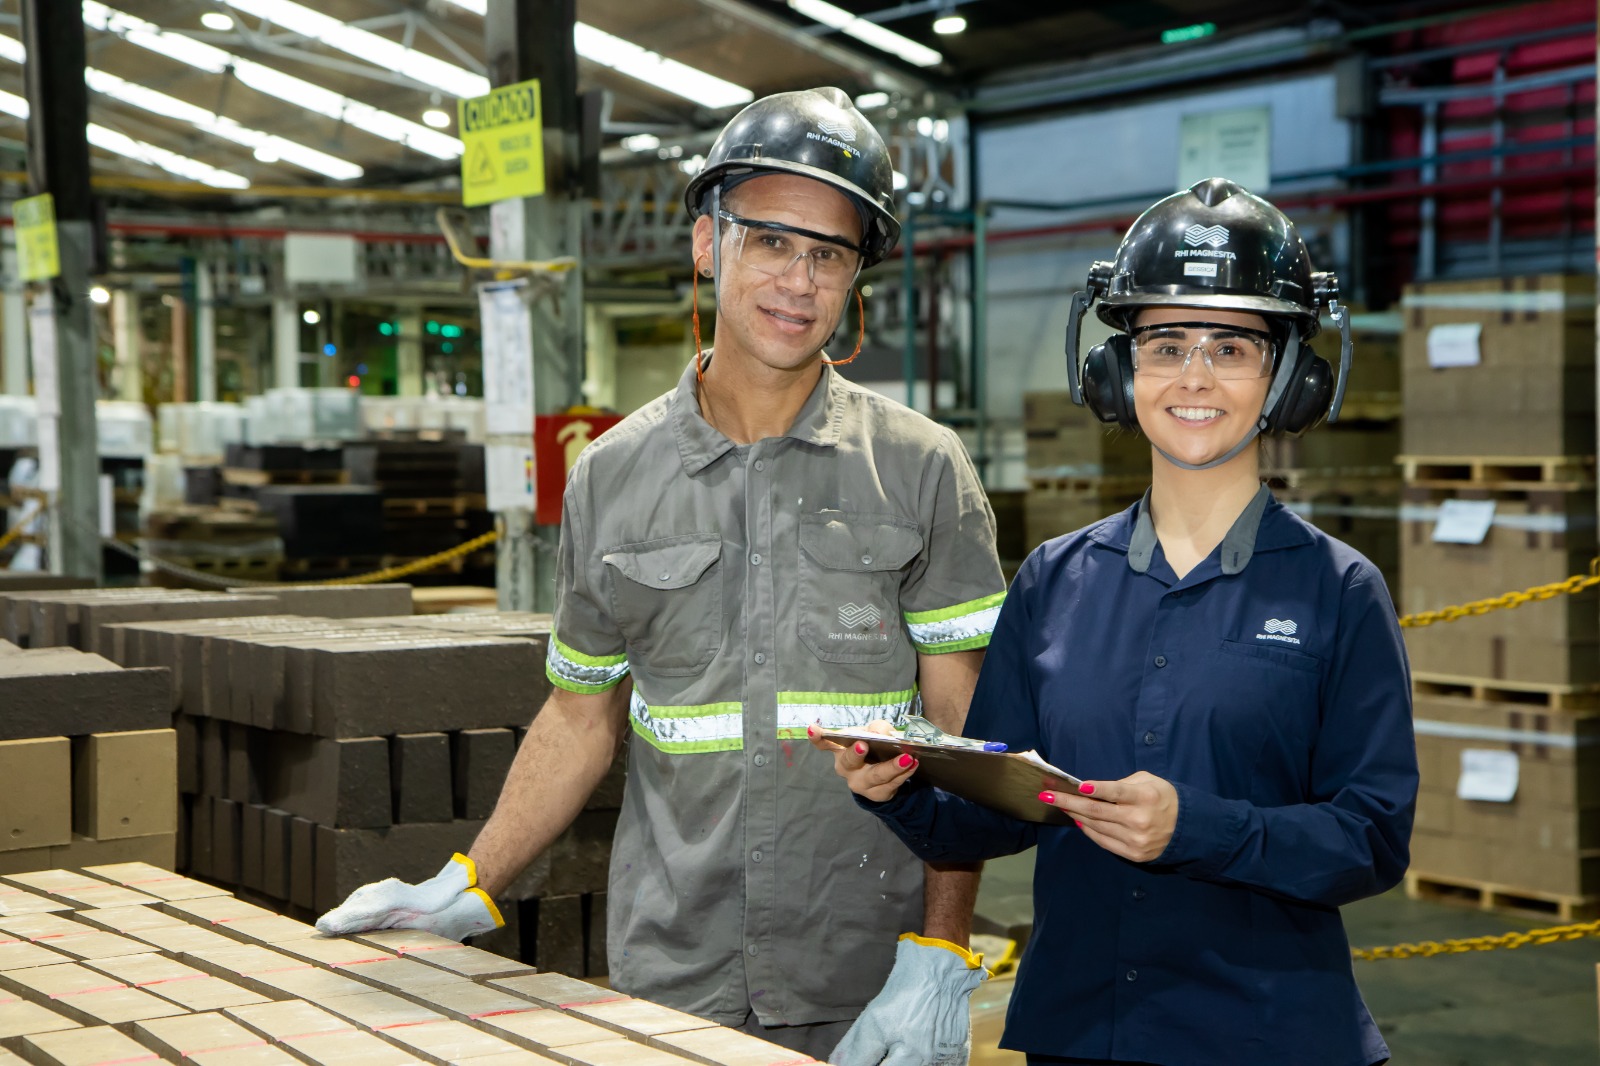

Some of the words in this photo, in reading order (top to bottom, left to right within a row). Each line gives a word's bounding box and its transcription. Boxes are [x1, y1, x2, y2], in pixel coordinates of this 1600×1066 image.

[806, 132, 820, 141] RHI
[821, 135, 861, 158] MAGNESITA
[1174, 250, 1189, 258] RHI
[1190, 249, 1236, 260] MAGNESITA
[828, 632, 843, 640] RHI
[844, 632, 888, 641] MAGNESTA
[1267, 634, 1300, 644] MAGNESITA
